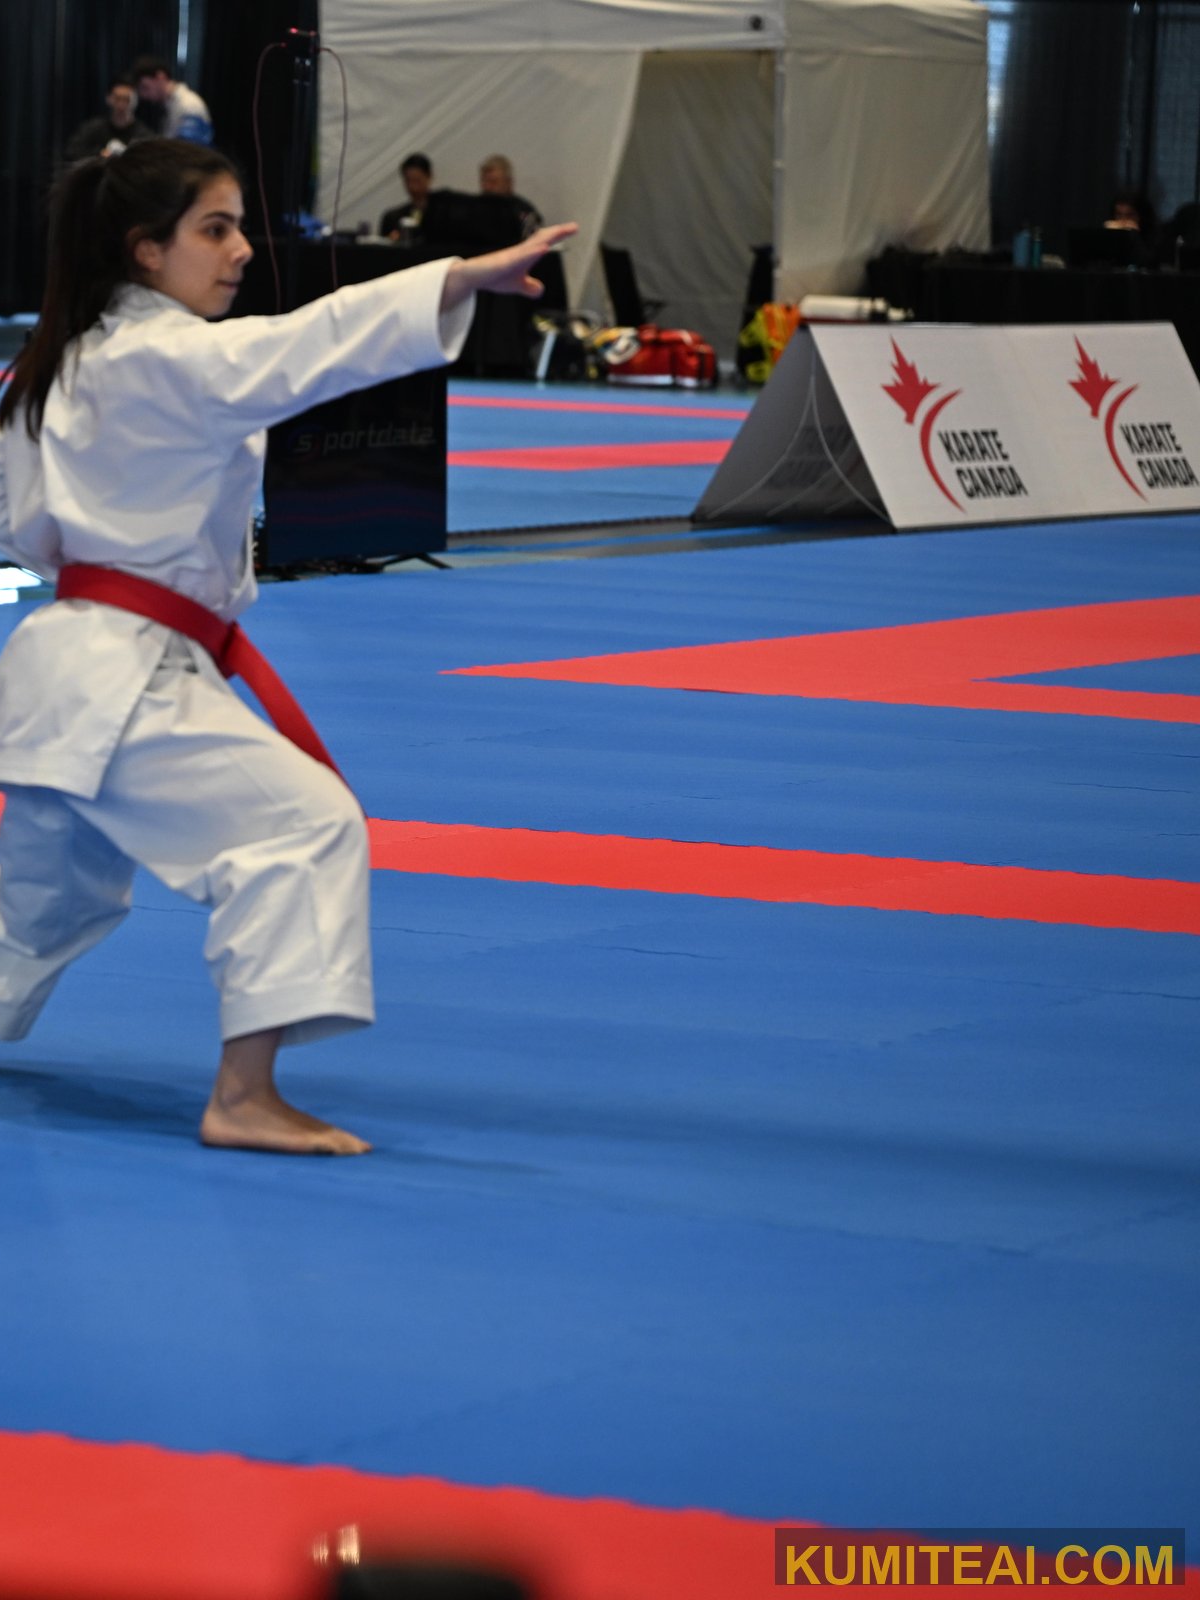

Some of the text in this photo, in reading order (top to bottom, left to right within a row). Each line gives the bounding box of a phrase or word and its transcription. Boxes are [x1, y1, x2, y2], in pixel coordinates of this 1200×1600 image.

[937, 429, 1010, 462] KARATE
[1120, 422, 1182, 455] KARATE
[956, 465, 1029, 499] CANADA
[1137, 456, 1199, 489] CANADA
